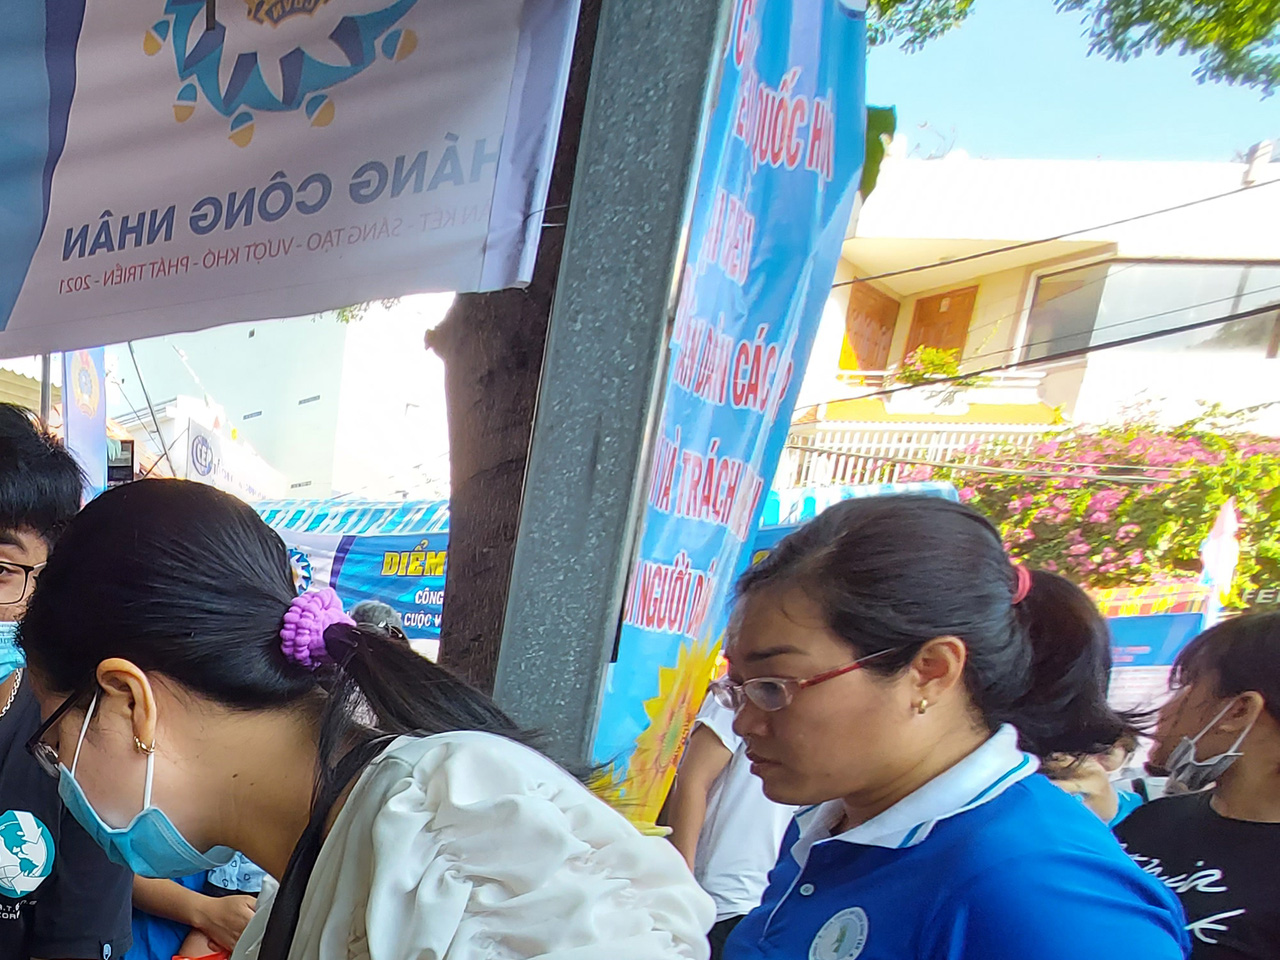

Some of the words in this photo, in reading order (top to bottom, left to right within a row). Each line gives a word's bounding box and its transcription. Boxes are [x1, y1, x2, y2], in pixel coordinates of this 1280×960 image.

[732, 322, 777, 413] CÁC
[675, 436, 743, 528] TRÁCH
[403, 610, 432, 630] CUỘC
[414, 586, 445, 606] CÔNG
